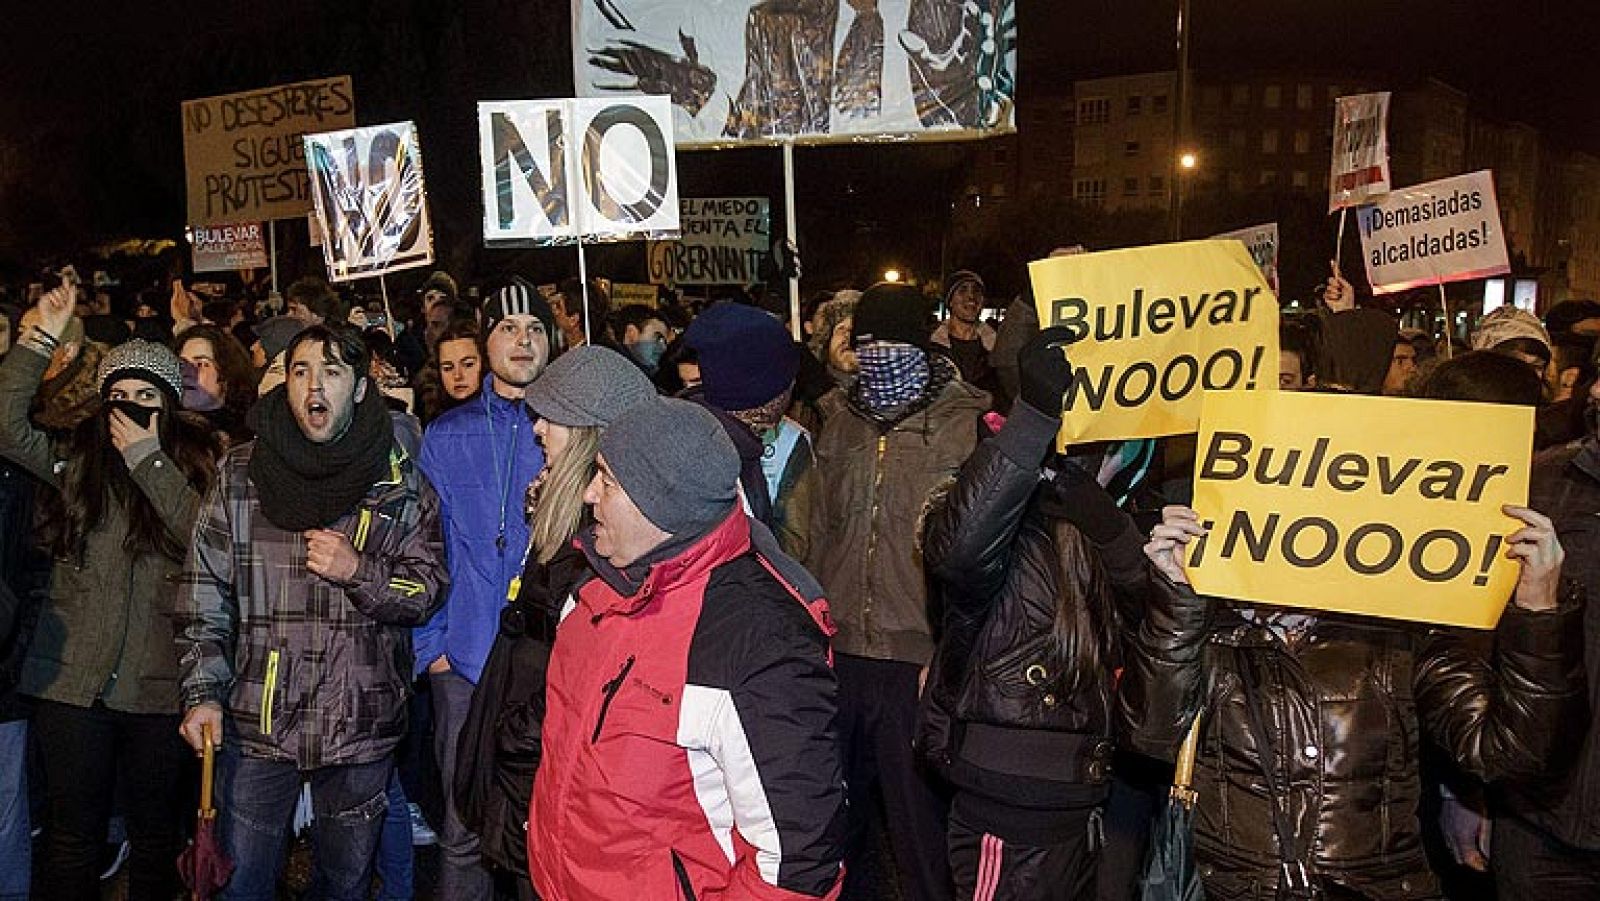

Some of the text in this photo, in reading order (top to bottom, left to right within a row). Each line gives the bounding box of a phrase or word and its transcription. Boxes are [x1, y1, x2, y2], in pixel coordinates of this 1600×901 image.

[186, 102, 211, 133] NO
[491, 104, 670, 230] NO
[680, 199, 759, 216] EL MIEDO
[680, 218, 768, 238] IENTA EL
[1366, 189, 1482, 239] ¡Demasiadas
[1371, 220, 1488, 268] alcaldadas!
[1051, 287, 1262, 342] Bulevar
[1200, 430, 1509, 503] Bulevar
[1189, 510, 1504, 587] ¡NOOO!
